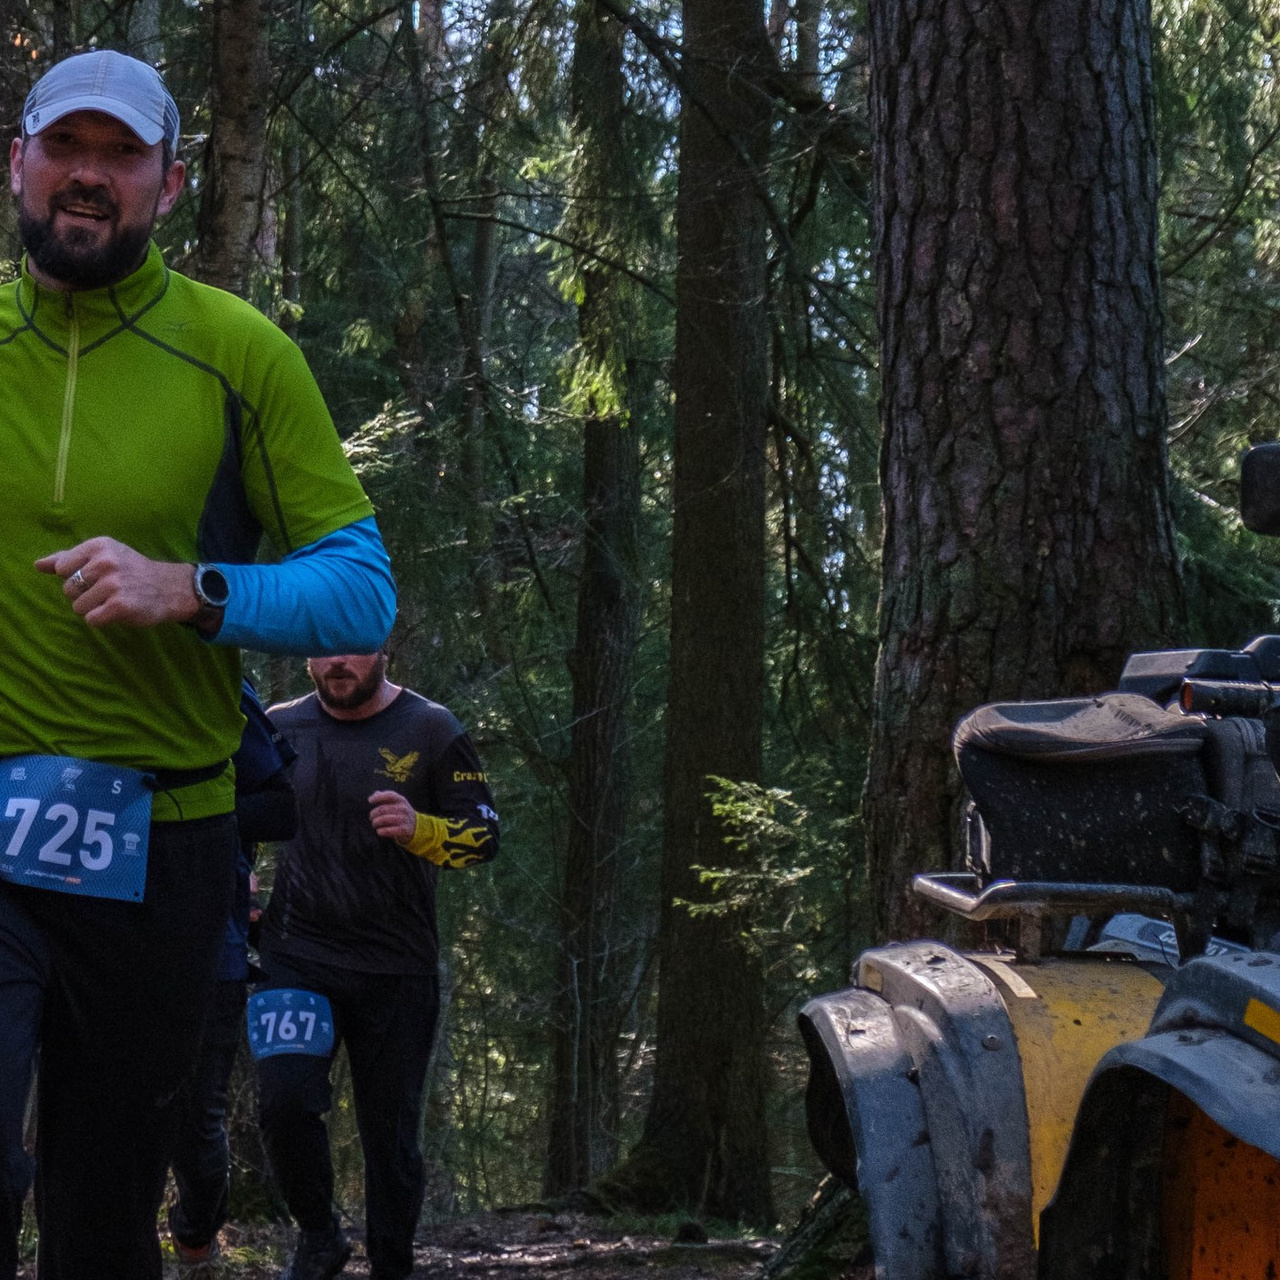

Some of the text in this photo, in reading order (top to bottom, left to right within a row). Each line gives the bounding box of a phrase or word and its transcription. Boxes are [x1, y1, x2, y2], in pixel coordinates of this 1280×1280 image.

[111, 780, 123, 795] S
[5, 797, 116, 871] 725
[260, 1010, 317, 1044] 767
